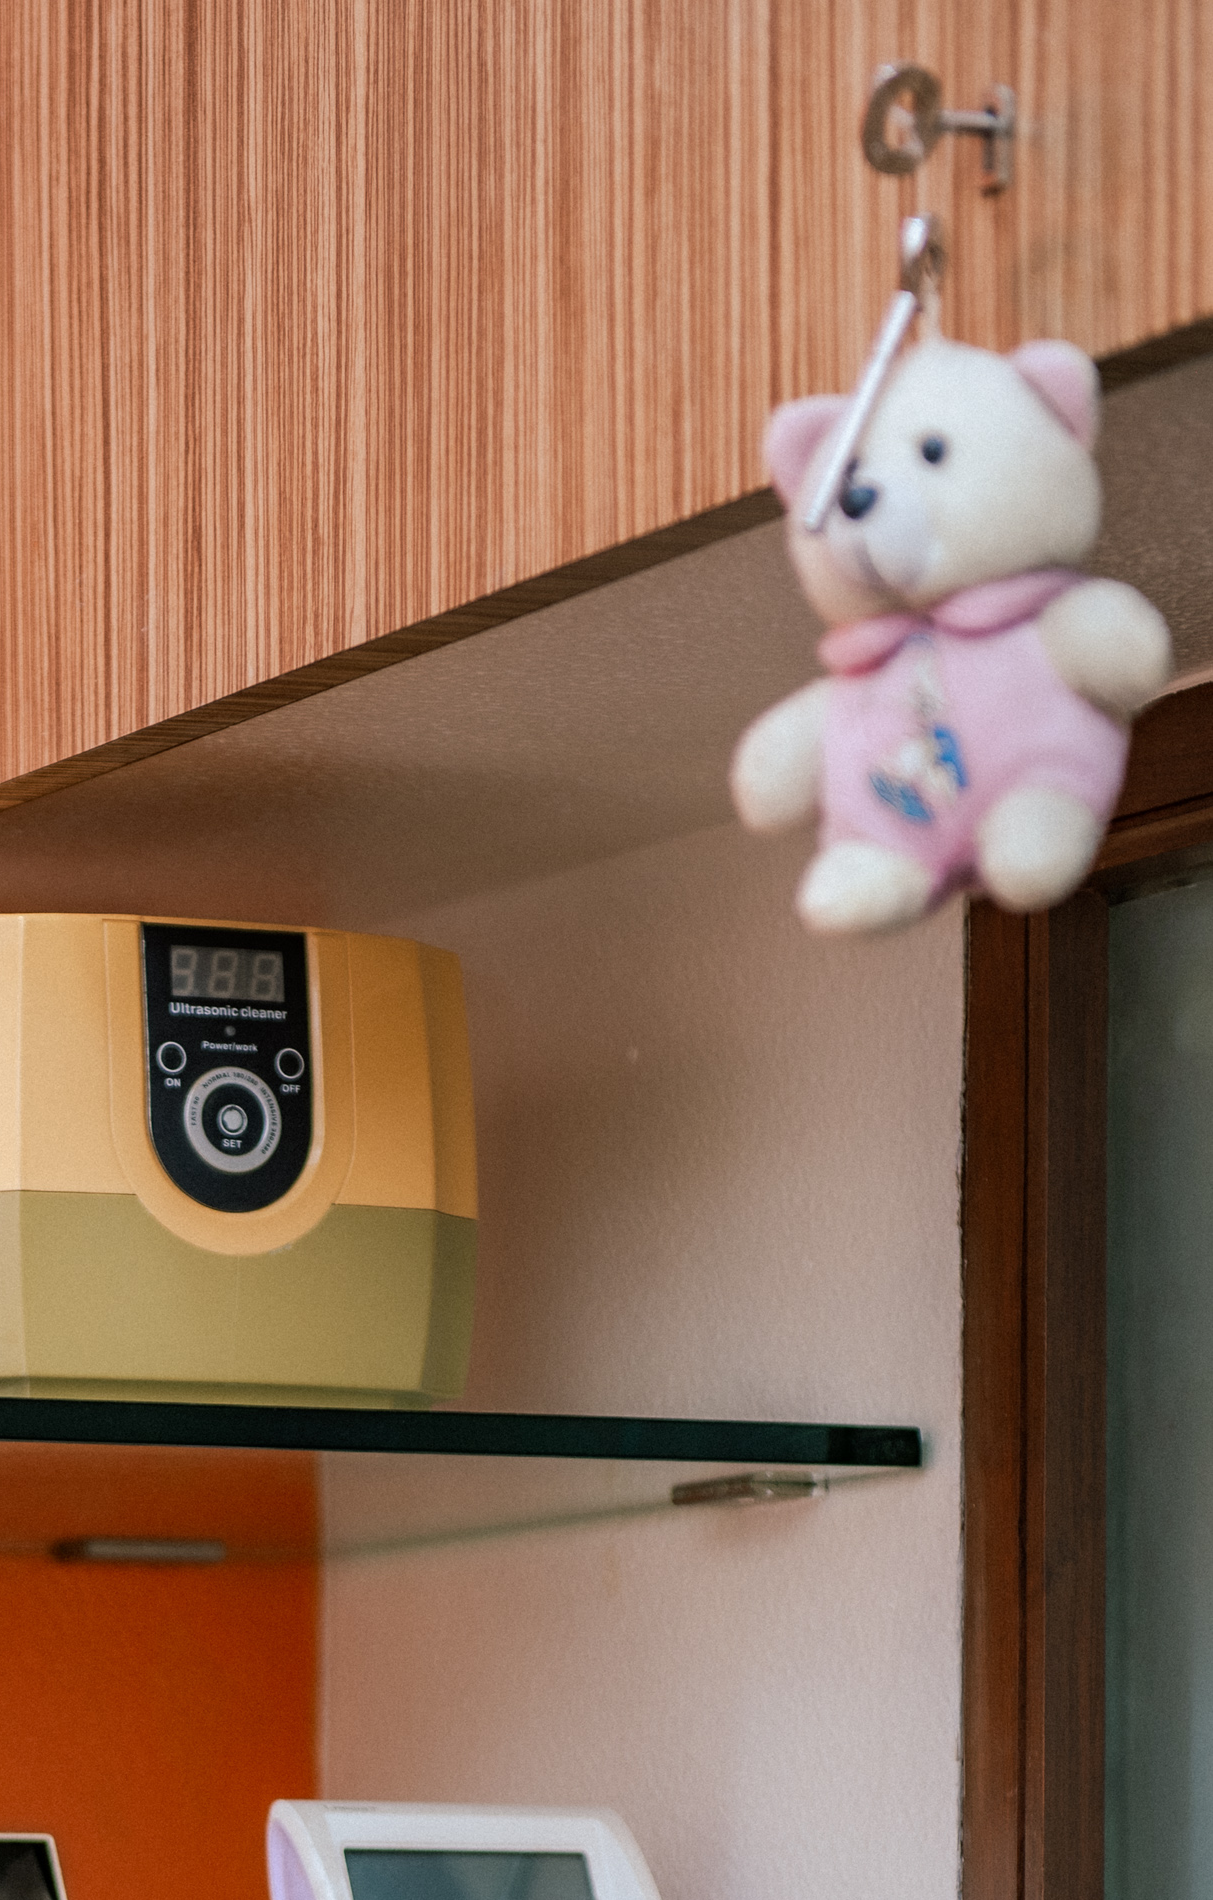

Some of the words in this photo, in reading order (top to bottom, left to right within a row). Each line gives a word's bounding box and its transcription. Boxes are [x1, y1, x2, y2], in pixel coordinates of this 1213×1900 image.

[169, 1002, 239, 1017] Ultrasonic
[241, 1006, 287, 1019] cleaner
[202, 1041, 258, 1052] Power/work
[166, 1078, 181, 1087] ON
[202, 1072, 231, 1089] NORMAL
[282, 1084, 301, 1094] OFF
[223, 1139, 243, 1148] SET
